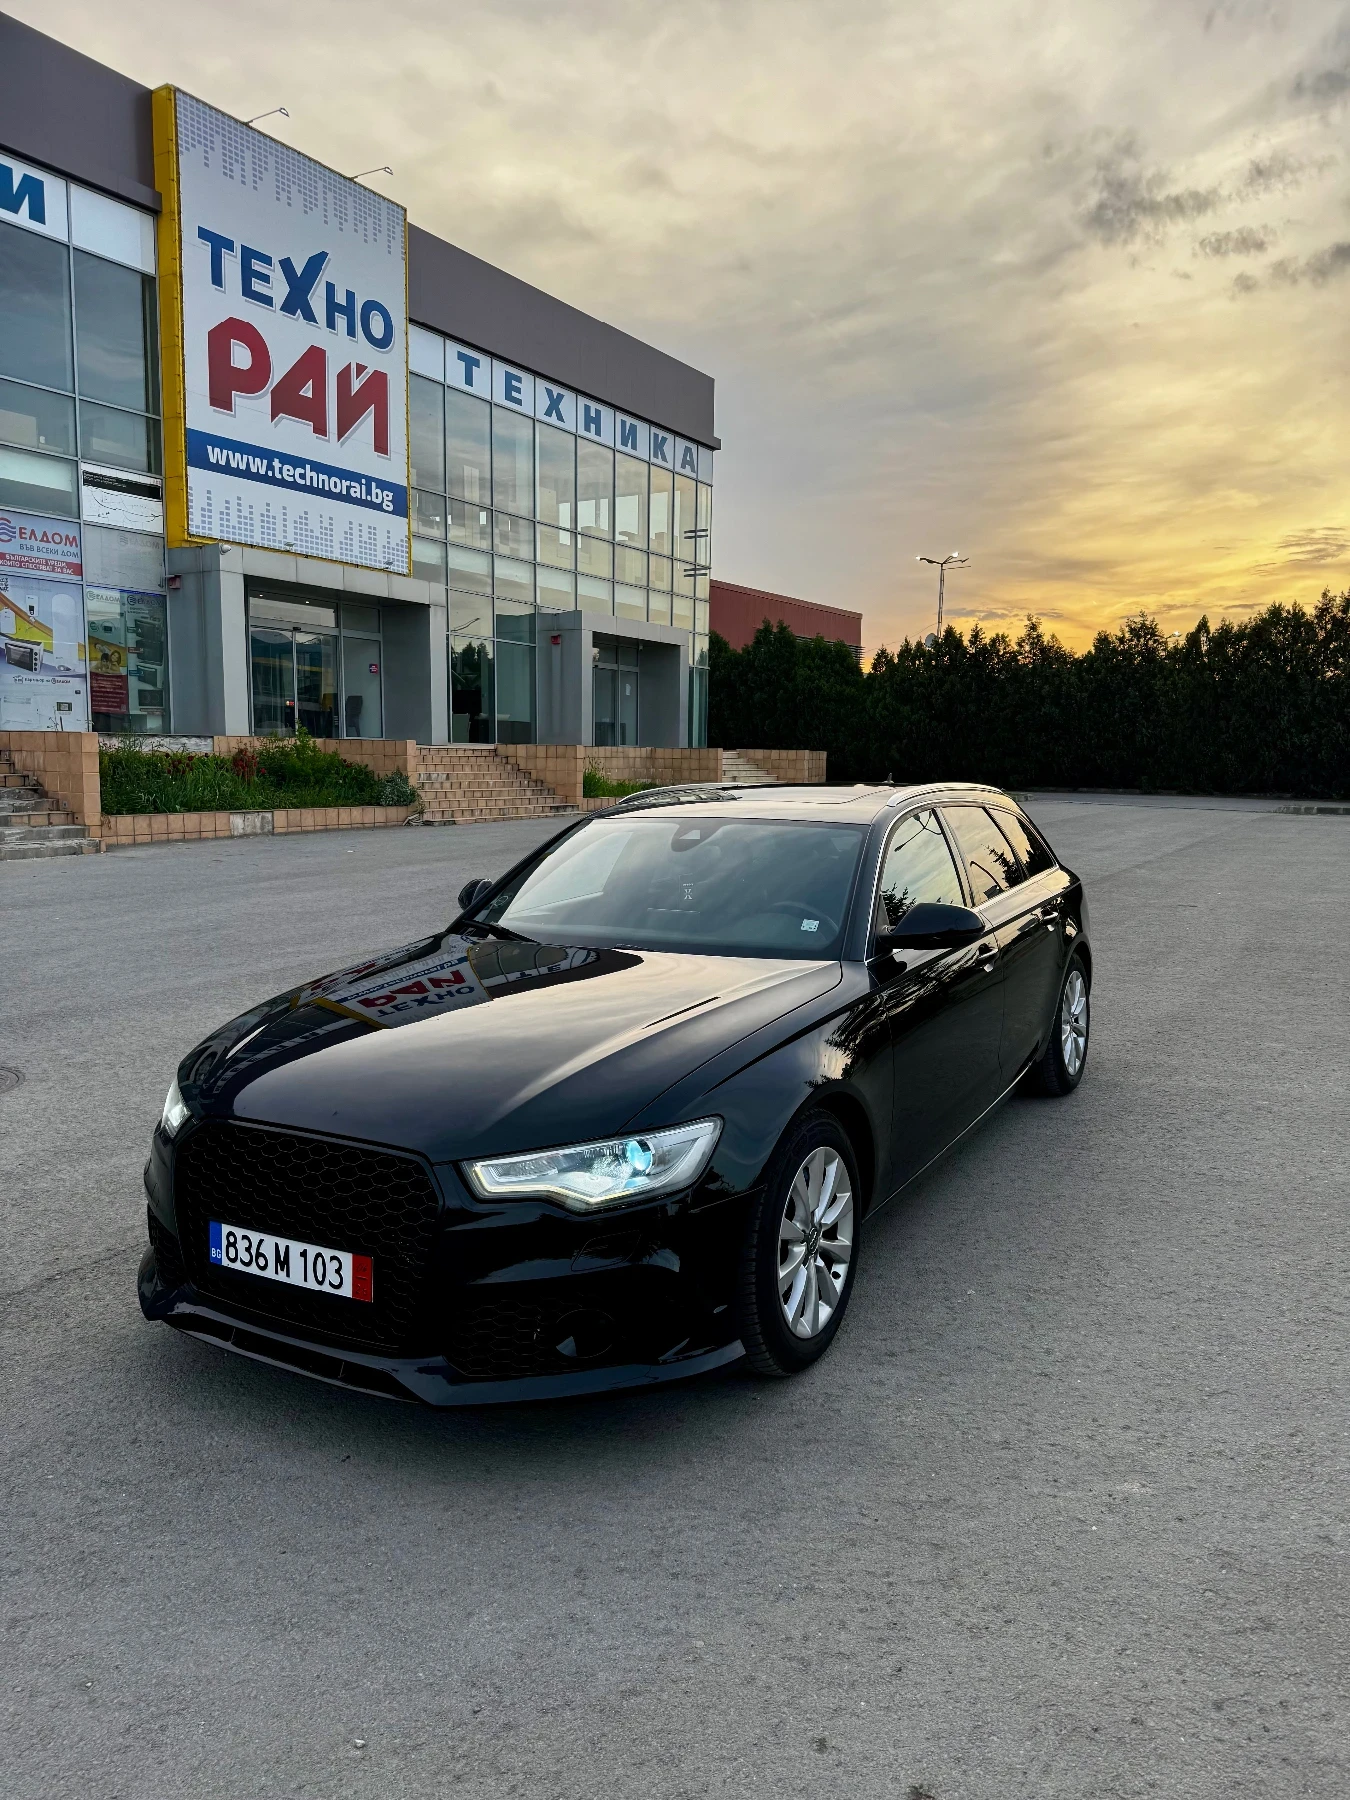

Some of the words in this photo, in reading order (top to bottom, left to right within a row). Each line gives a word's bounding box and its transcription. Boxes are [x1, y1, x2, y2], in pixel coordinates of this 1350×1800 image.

[197, 225, 394, 351] ТЕХНО
[207, 316, 391, 457] РАЙ
[457, 351, 696, 474] ТЕХНИКА
[206, 443, 394, 511] www.technorai.bg
[19, 526, 78, 548] ЕЛДОМ
[19, 543, 35, 552] ВЪВ
[36, 546, 59, 556] ВСЕКИ
[60, 550, 79, 558] ДОМ
[211, 1247, 222, 1259] BG
[225, 1230, 269, 1271] 836
[274, 1242, 291, 1278] M
[299, 1248, 344, 1290] 103
